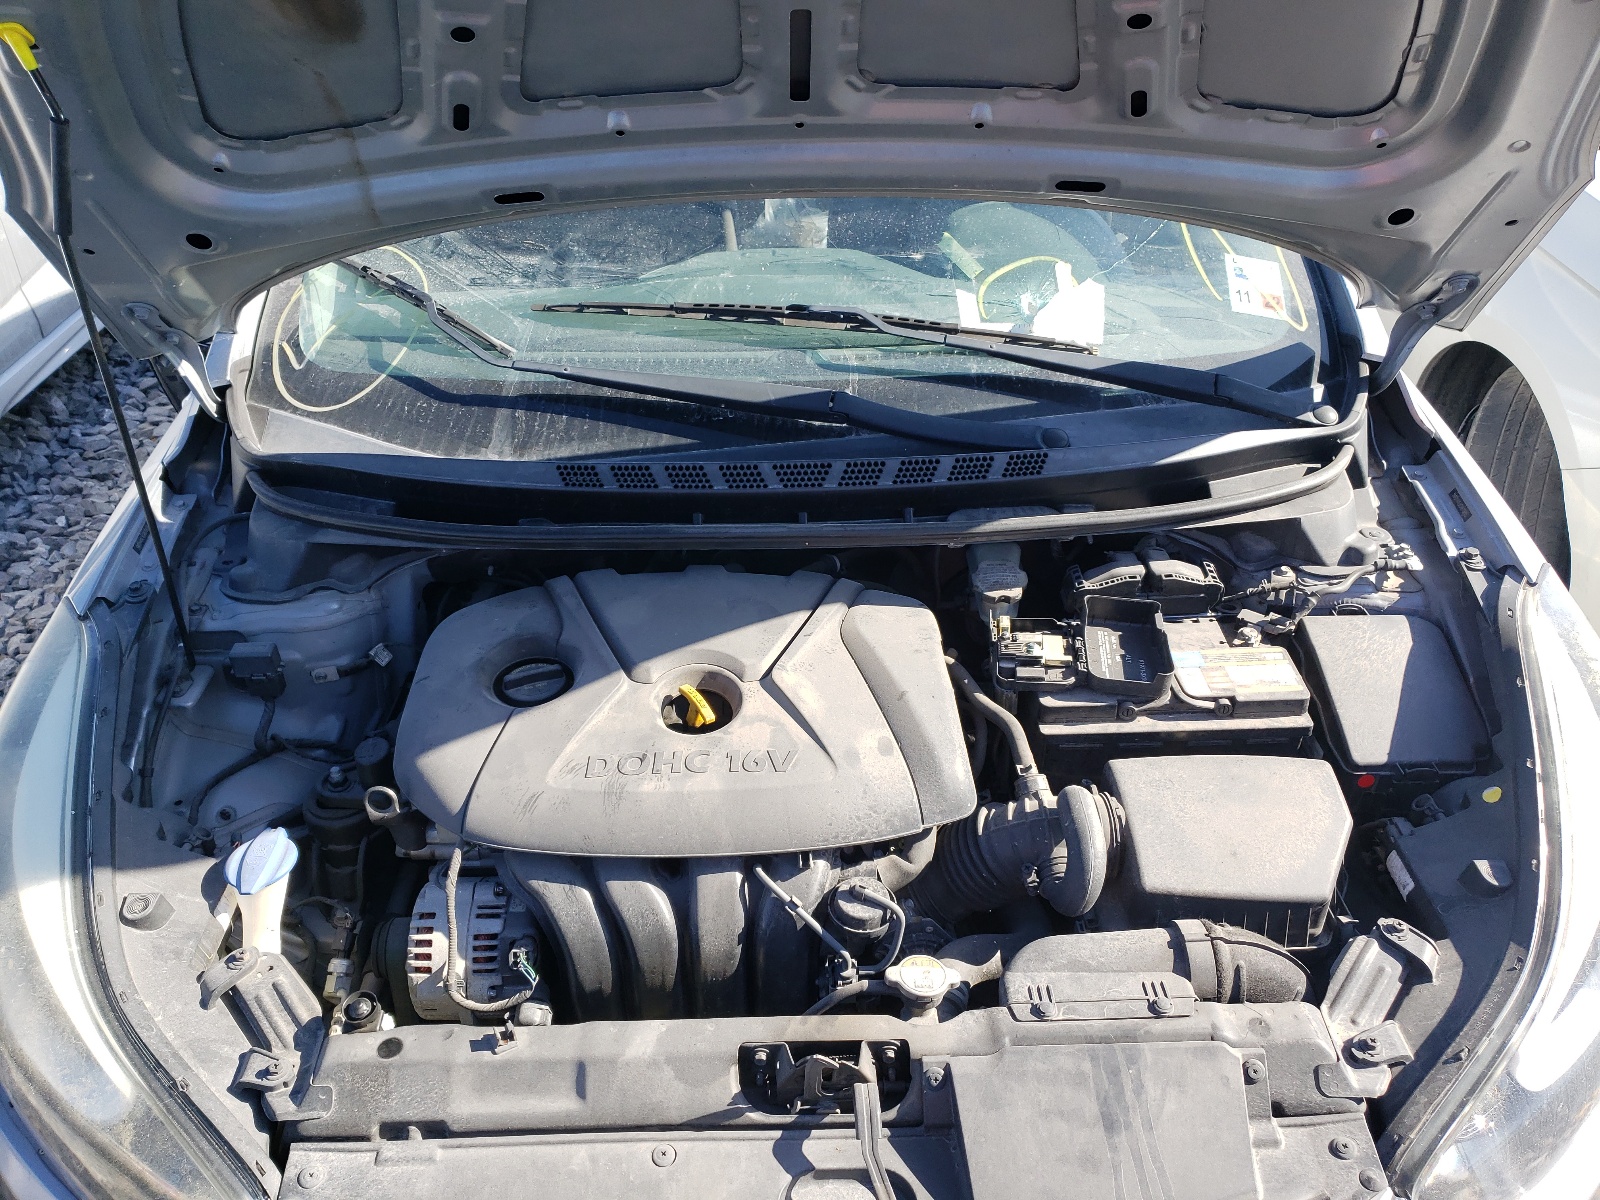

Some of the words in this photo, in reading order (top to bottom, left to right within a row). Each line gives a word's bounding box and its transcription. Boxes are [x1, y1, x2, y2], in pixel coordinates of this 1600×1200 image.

[1235, 289, 1251, 304] 11
[584, 750, 711, 779] DOHC
[725, 748, 799, 774] 16V
